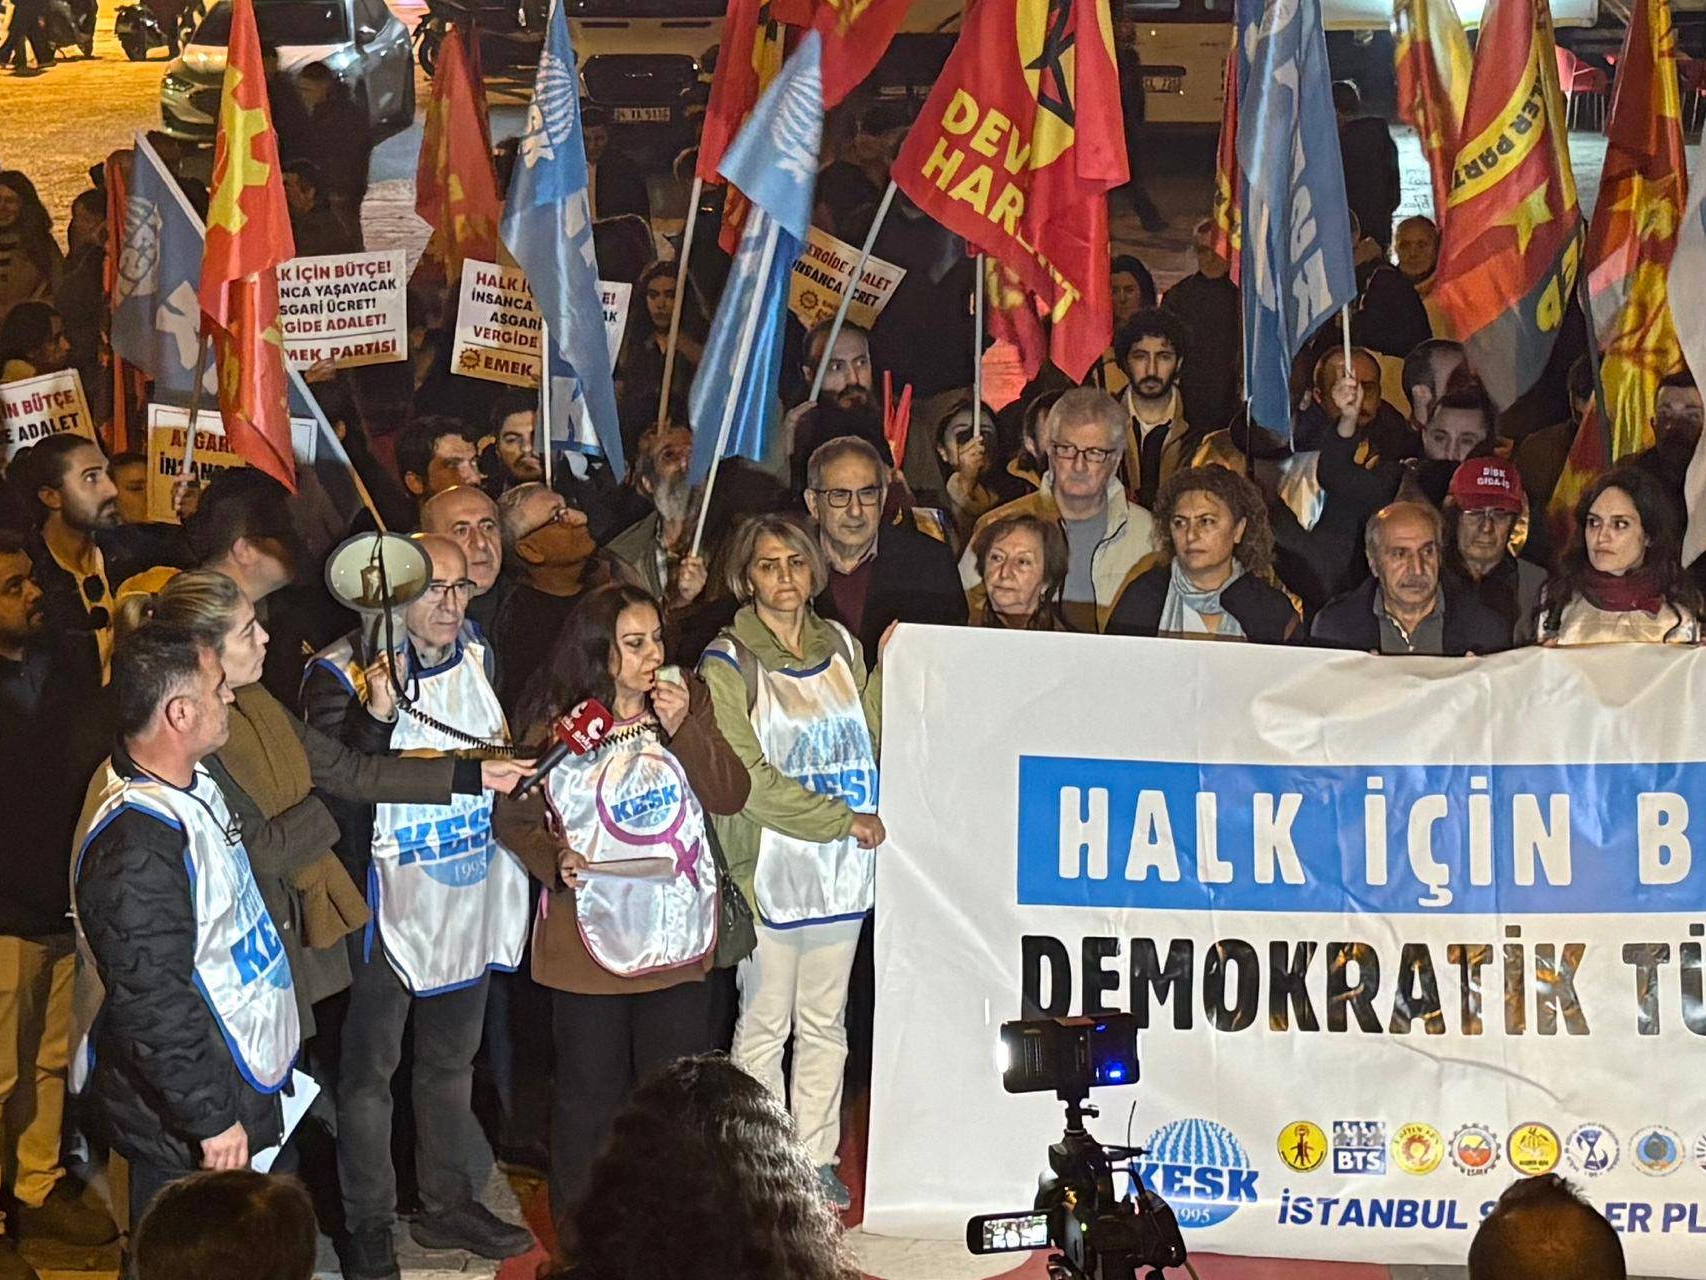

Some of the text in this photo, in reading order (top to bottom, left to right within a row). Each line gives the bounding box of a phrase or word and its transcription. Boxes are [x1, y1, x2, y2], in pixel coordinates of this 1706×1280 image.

[1454, 133, 1515, 191] PART
[296, 264, 330, 284] İÇİN
[334, 260, 391, 278] BÜTÇE!
[476, 271, 518, 290] HALK
[848, 266, 892, 291] AALET
[315, 279, 397, 299] YAŞAYACAK
[471, 287, 533, 312] İNSANCA
[843, 287, 881, 307] CRET
[279, 298, 376, 315] SGARİ ÜCRET!
[284, 313, 387, 333] GİDE ADALET!
[473, 325, 538, 349] VERGİDE
[286, 349, 322, 361] MEK
[484, 356, 533, 377] EMEK
[23, 389, 76, 414] BÜTÇE
[18, 412, 80, 442] ADALET
[609, 782, 680, 823] KESK
[395, 807, 491, 867] KES
[1058, 784, 1307, 887] HALK
[1365, 777, 1574, 906] İÇİN
[230, 911, 283, 987] KE
[1021, 924, 1590, 1038] DEMOKRATİK
[1338, 1151, 1382, 1169] BTS
[1130, 1162, 1260, 1204] KESK
[1278, 1188, 1468, 1230] İSTANBUL
